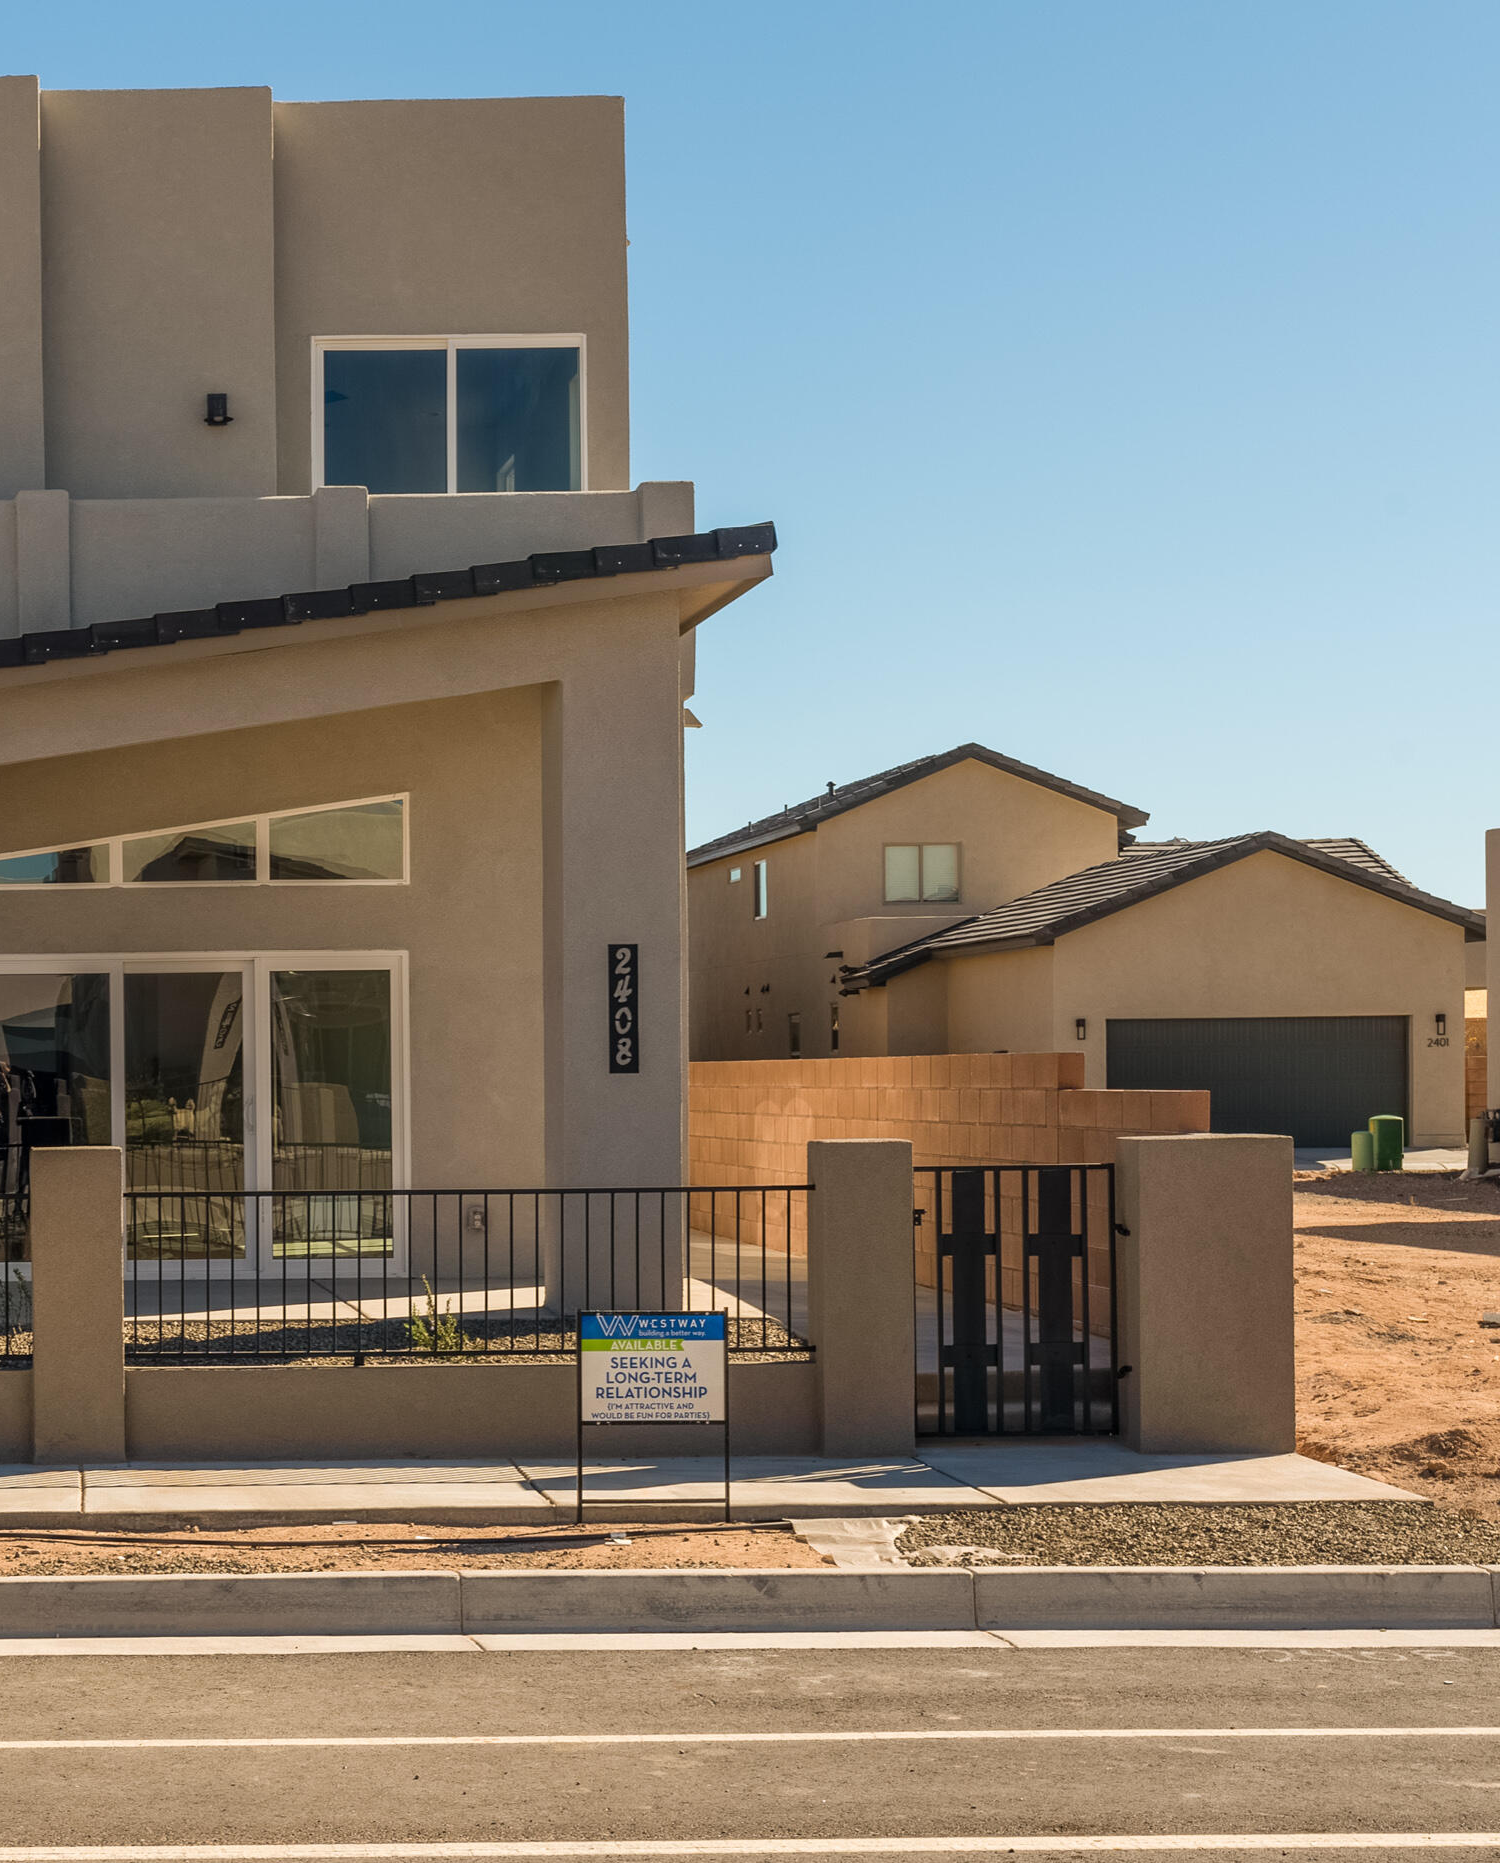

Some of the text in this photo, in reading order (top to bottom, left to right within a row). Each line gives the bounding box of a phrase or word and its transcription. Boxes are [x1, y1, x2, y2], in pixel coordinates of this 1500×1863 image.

[613, 947, 633, 1066] 2408
[1427, 1038, 1450, 1048] 2401
[639, 1319, 706, 1328] WESTWAY
[611, 1340, 678, 1351] AVAILABLE
[610, 1357, 692, 1369] SEEKING A
[606, 1372, 697, 1384] LONG-TERM
[596, 1386, 708, 1398] RELATIONSHIP
